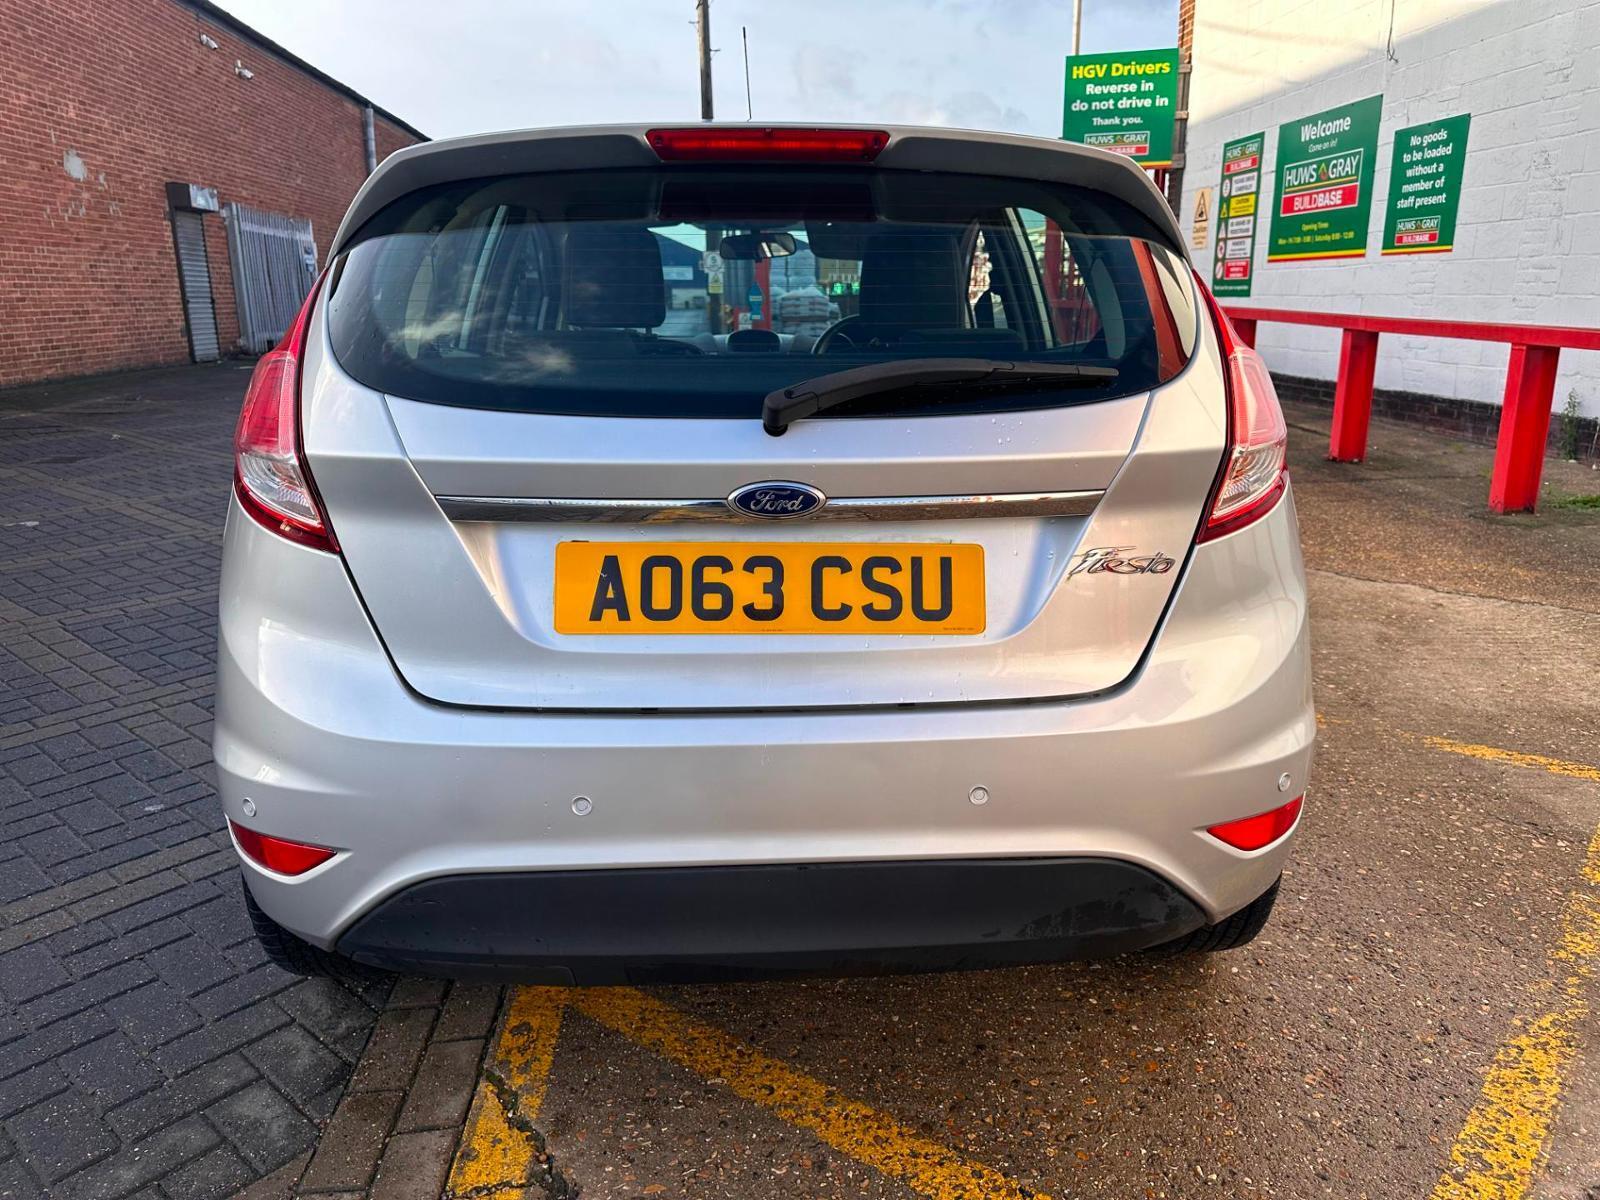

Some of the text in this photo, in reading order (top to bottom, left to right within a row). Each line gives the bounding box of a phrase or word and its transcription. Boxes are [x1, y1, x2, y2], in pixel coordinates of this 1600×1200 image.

[1072, 62, 1170, 79] HGV Drivers
[1086, 80, 1154, 95] Reverse in
[1071, 95, 1168, 111] do not drive in
[1092, 116, 1143, 126] Thank you.
[1301, 117, 1351, 142] Welcome
[1086, 134, 1146, 144] HUWS GRAY
[1410, 129, 1447, 146] No goods
[1308, 143, 1322, 152] Come
[1322, 142, 1329, 150] on
[1403, 142, 1452, 163] to be loaded
[1286, 155, 1360, 187] HUWS GRAY
[1406, 163, 1444, 177] without a
[1402, 176, 1445, 193] member of
[1294, 190, 1343, 210] BUILDBASE
[1397, 193, 1446, 208] staff present
[1398, 219, 1438, 231] HUWS GRAY
[750, 490, 804, 511] Ford
[1066, 546, 1176, 581] Fiesta
[589, 555, 953, 622] AO63 CSU
